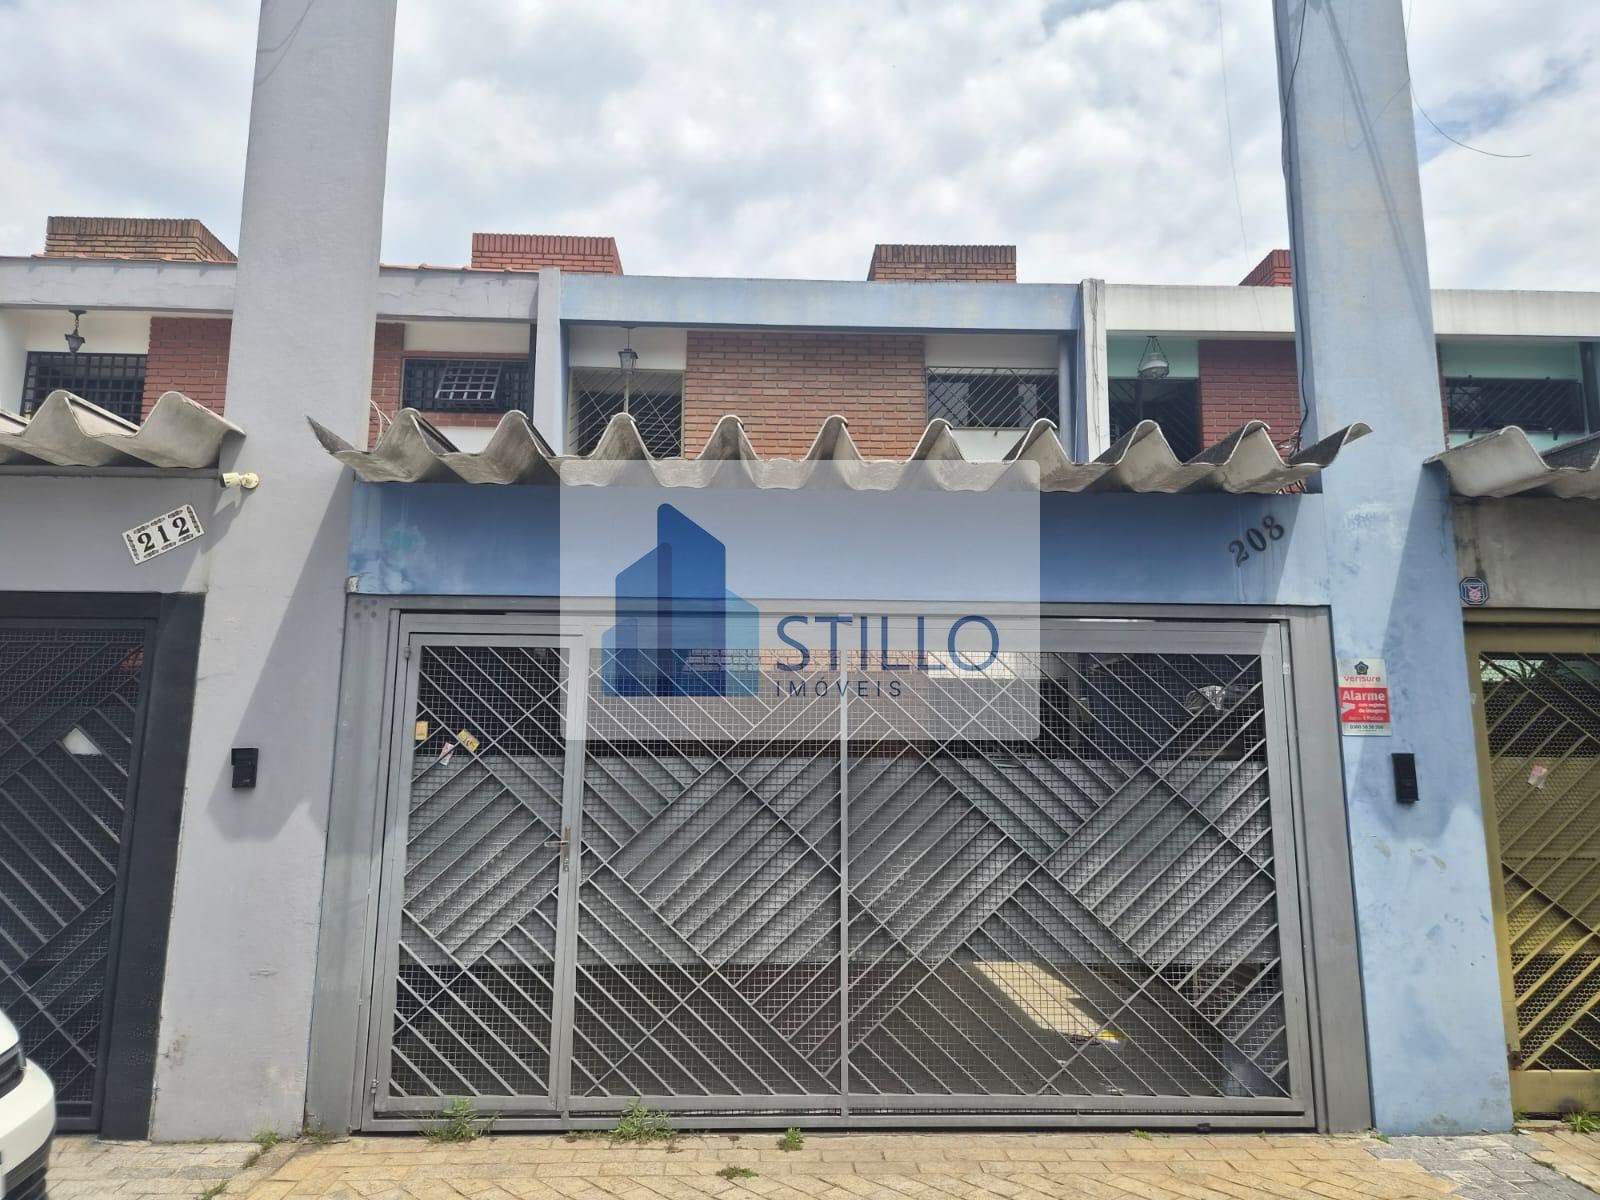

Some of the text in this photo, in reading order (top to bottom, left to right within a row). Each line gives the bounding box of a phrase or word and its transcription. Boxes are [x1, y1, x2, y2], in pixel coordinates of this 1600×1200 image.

[137, 516, 190, 553] 212
[1228, 515, 1284, 568] 208
[1342, 690, 1385, 701] Alarme
